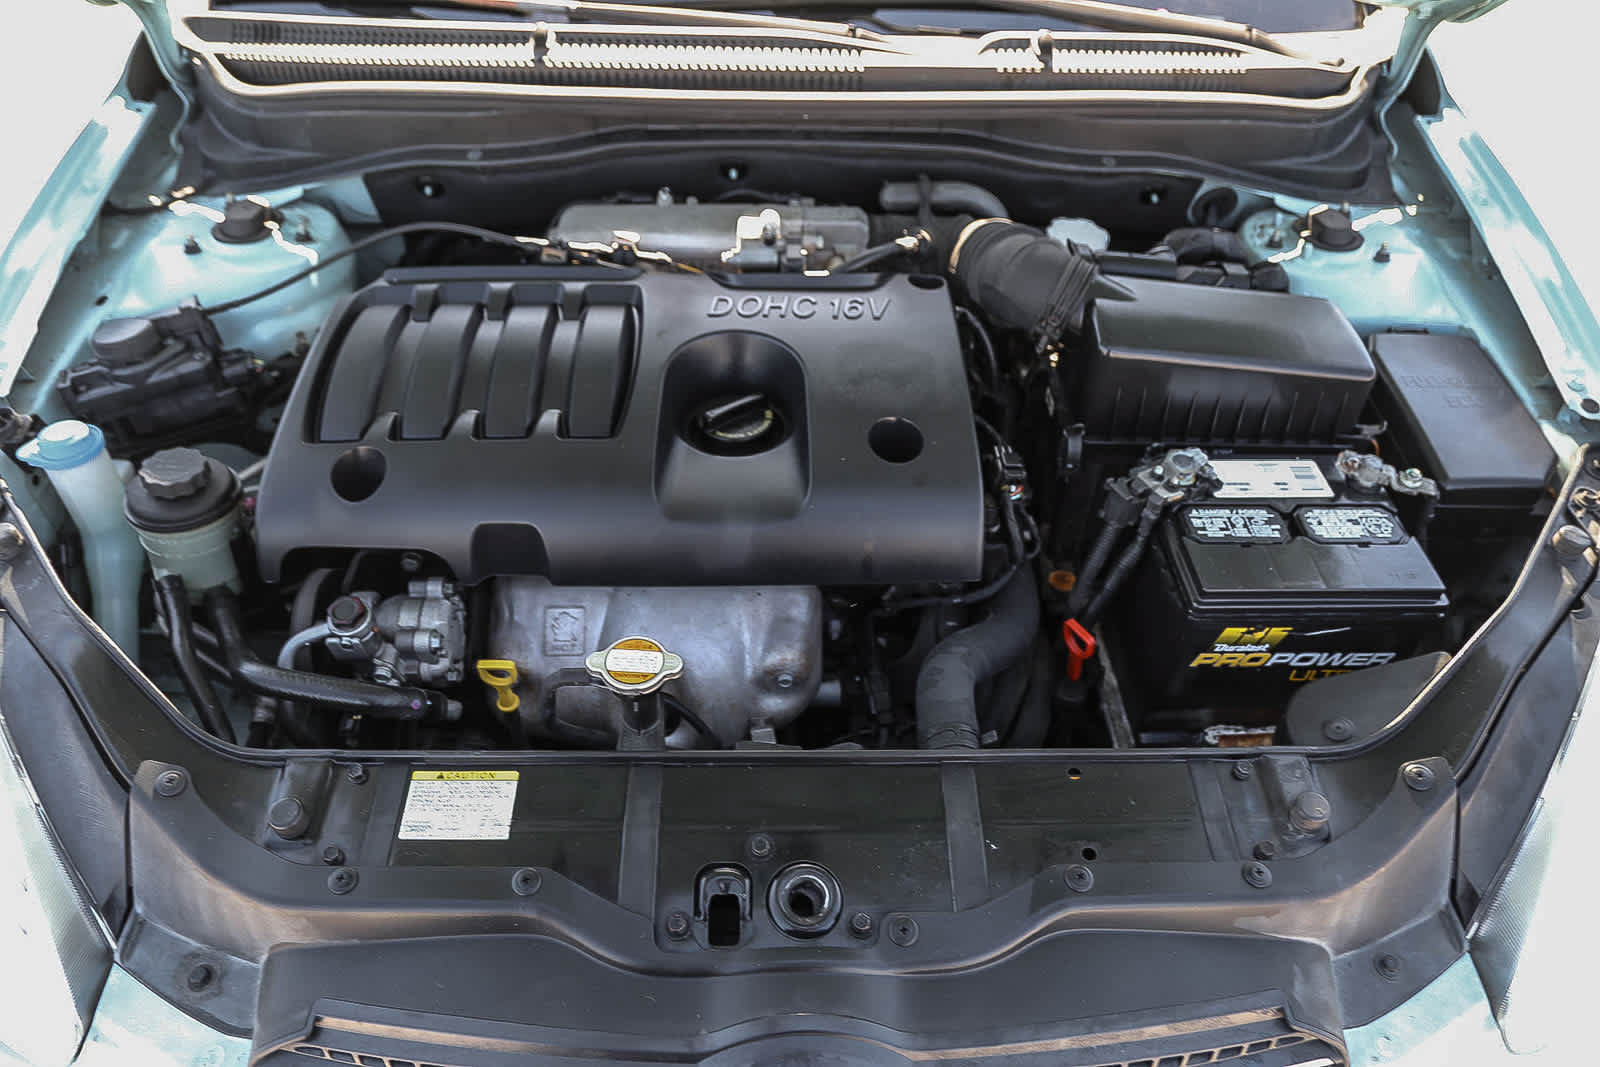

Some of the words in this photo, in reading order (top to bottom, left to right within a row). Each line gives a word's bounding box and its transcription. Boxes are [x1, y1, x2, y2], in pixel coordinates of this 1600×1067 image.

[706, 295, 817, 319] DOHC
[830, 297, 891, 321] 16V
[1213, 643, 1270, 652] Duralast
[445, 771, 497, 779] CAUTION
